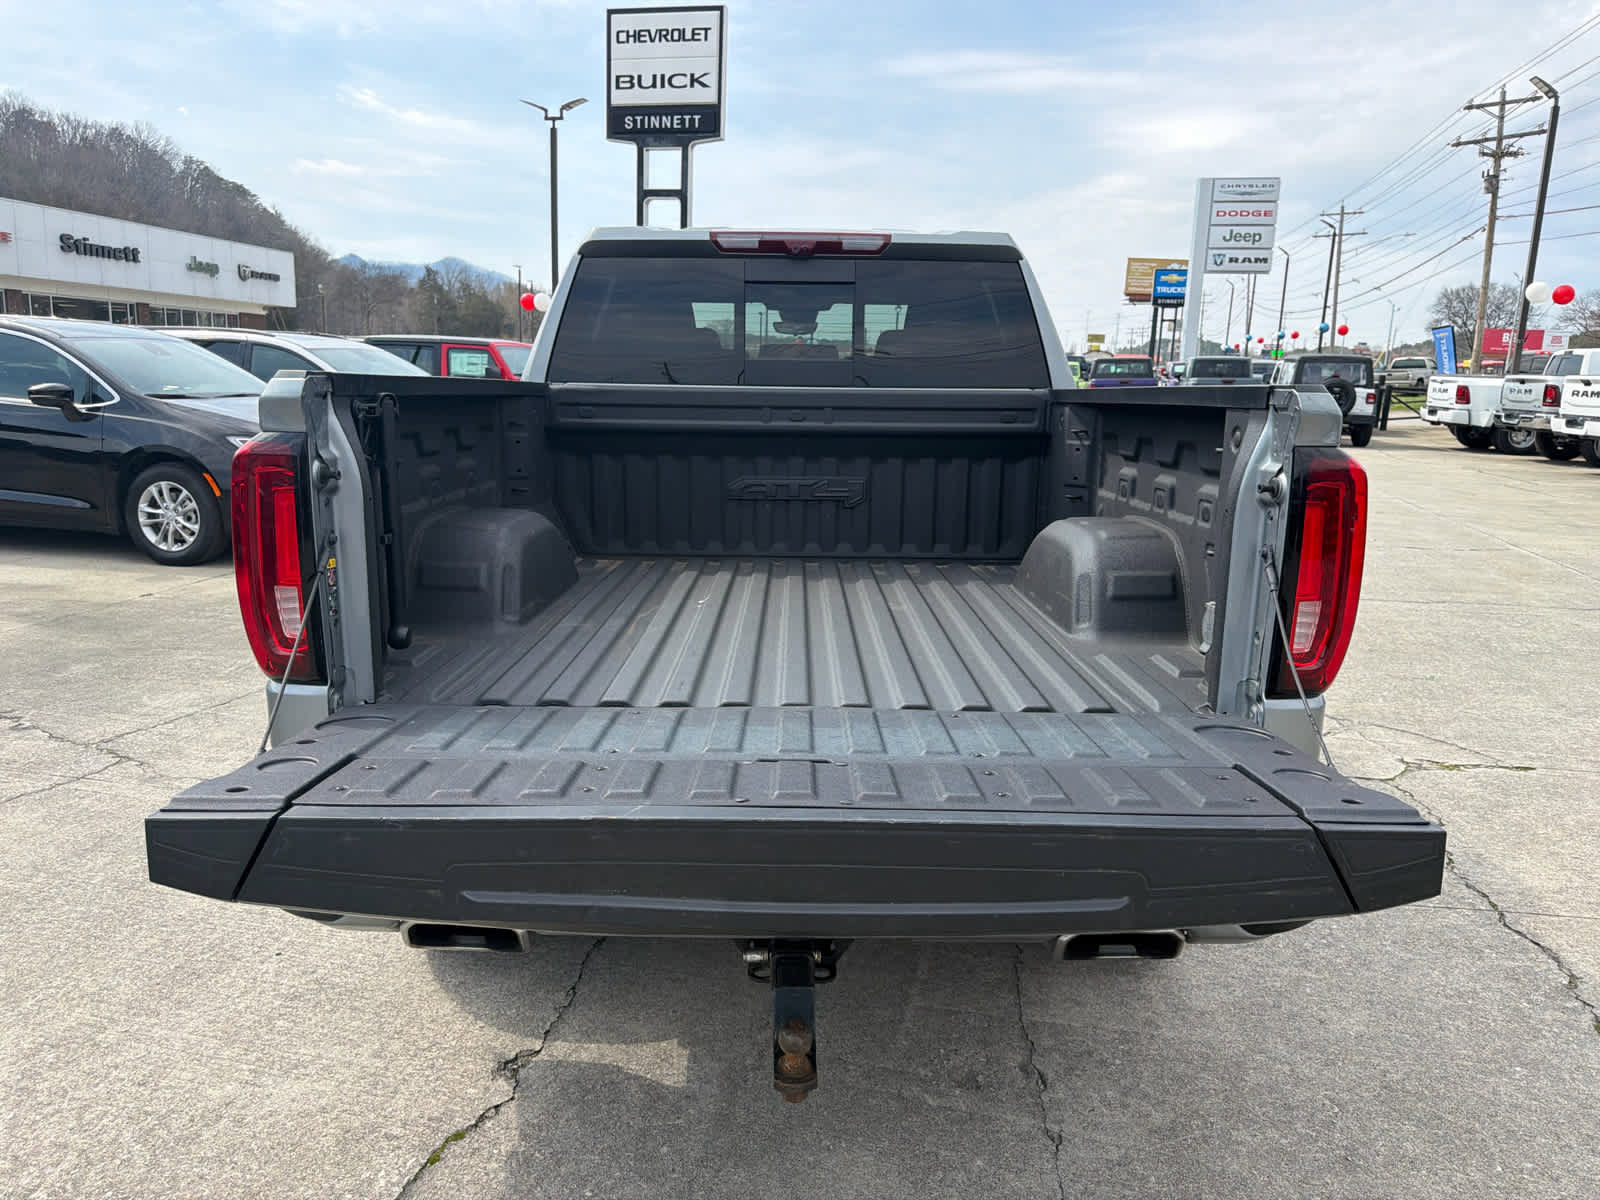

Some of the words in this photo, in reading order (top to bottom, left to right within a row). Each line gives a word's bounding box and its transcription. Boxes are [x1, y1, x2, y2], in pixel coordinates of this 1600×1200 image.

[616, 27, 712, 44] CHEVROLET
[615, 72, 711, 90] BUICK
[624, 115, 702, 129] STINNETT
[1222, 229, 1263, 246] Jeep
[59, 233, 141, 264] Stinnett
[186, 256, 220, 278] Jeep
[1509, 388, 1533, 396] RAM
[1571, 390, 1600, 399] RAM
